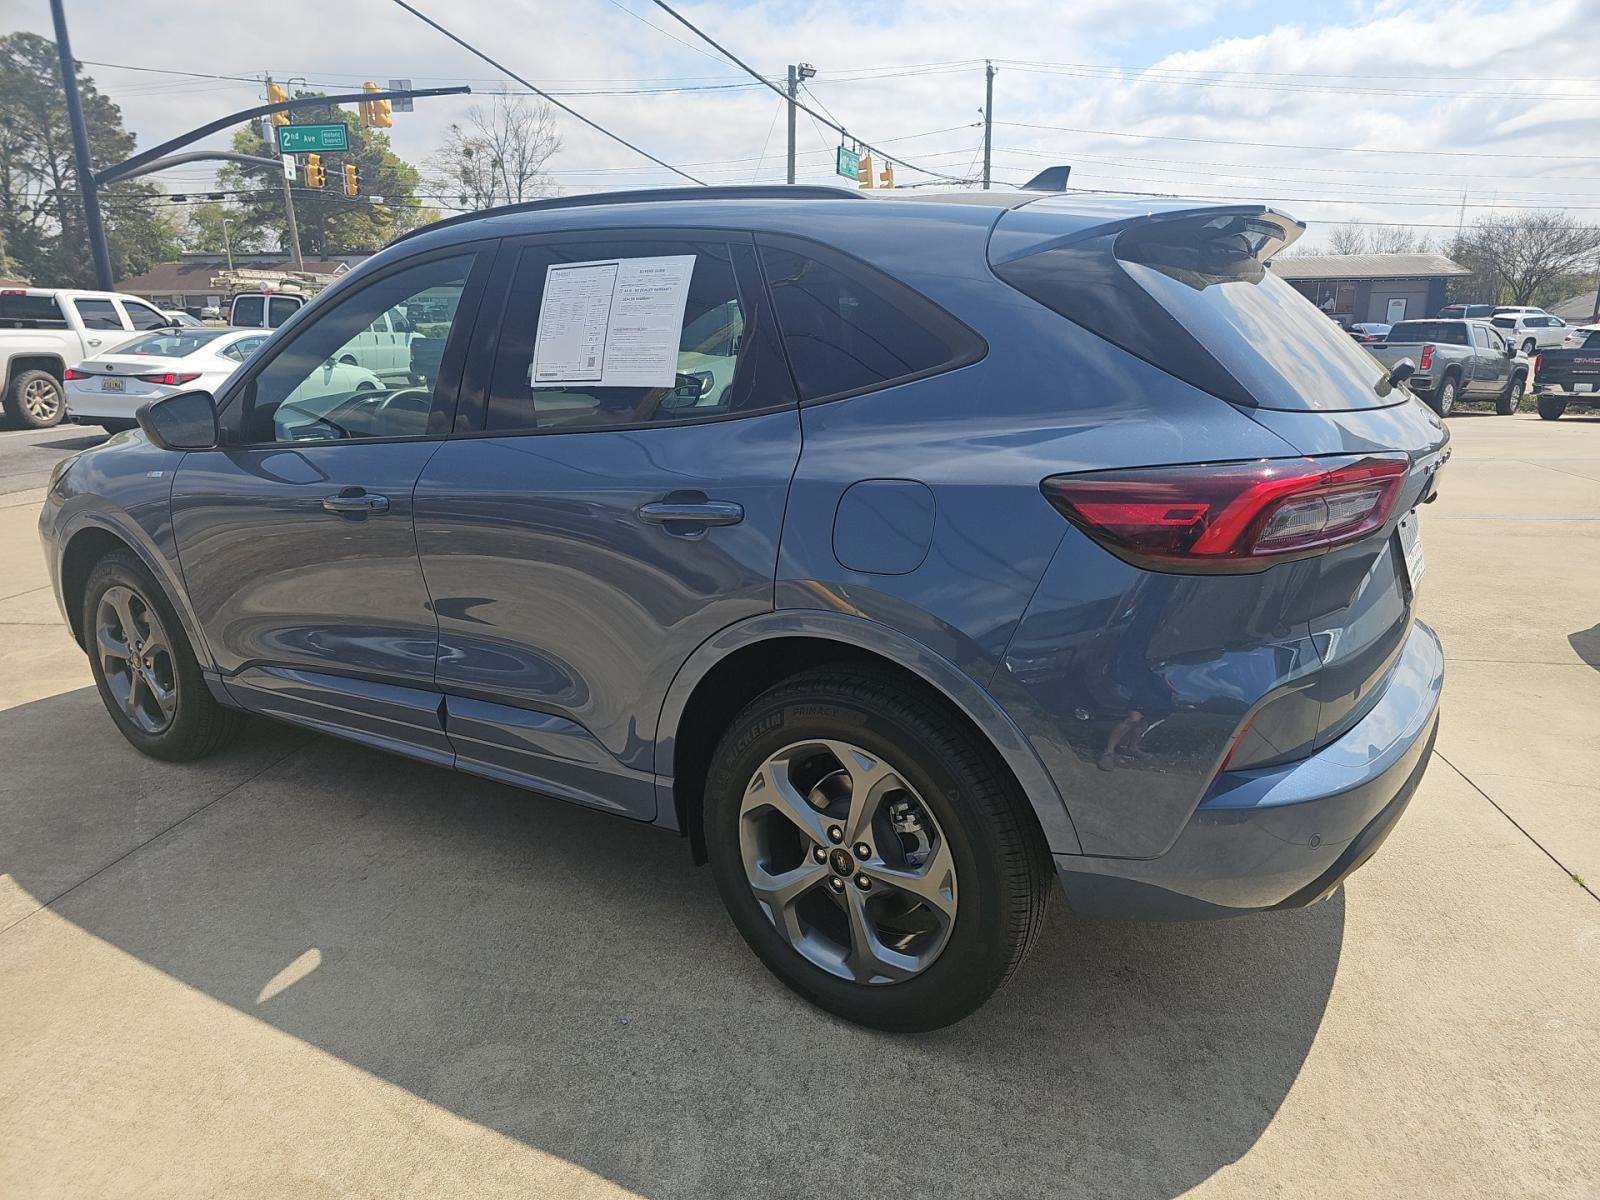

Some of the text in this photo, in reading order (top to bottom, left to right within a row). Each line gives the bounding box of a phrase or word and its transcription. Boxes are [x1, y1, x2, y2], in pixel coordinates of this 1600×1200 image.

[283, 132, 316, 147] 2nd Ave
[726, 711, 784, 766] MICHELIN
